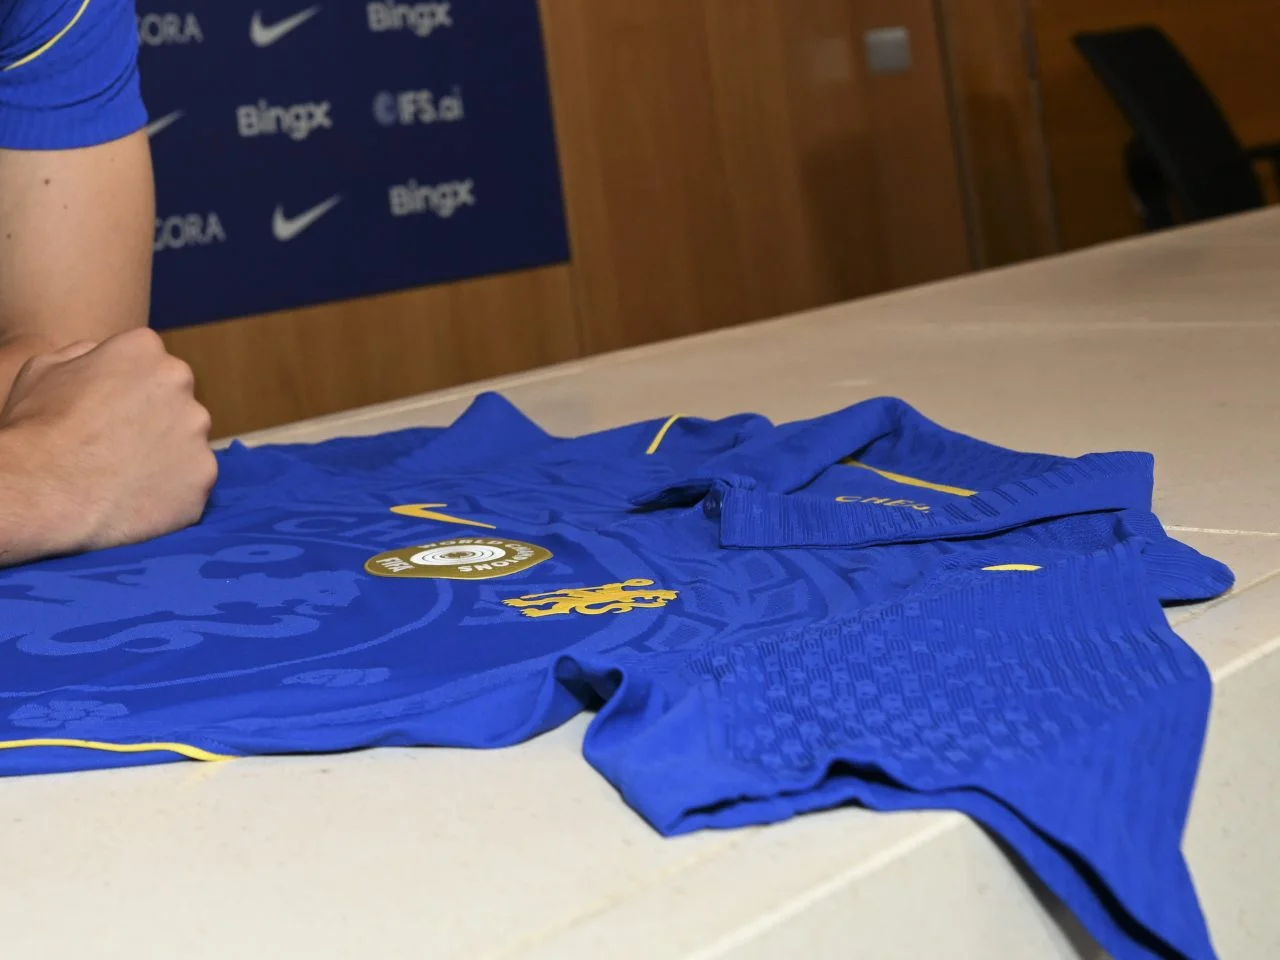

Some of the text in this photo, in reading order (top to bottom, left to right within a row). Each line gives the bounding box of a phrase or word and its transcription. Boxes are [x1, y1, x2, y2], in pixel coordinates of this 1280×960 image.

[137, 12, 204, 47] ORA
[156, 212, 227, 252] ORA
[376, 556, 416, 573] FIFA
